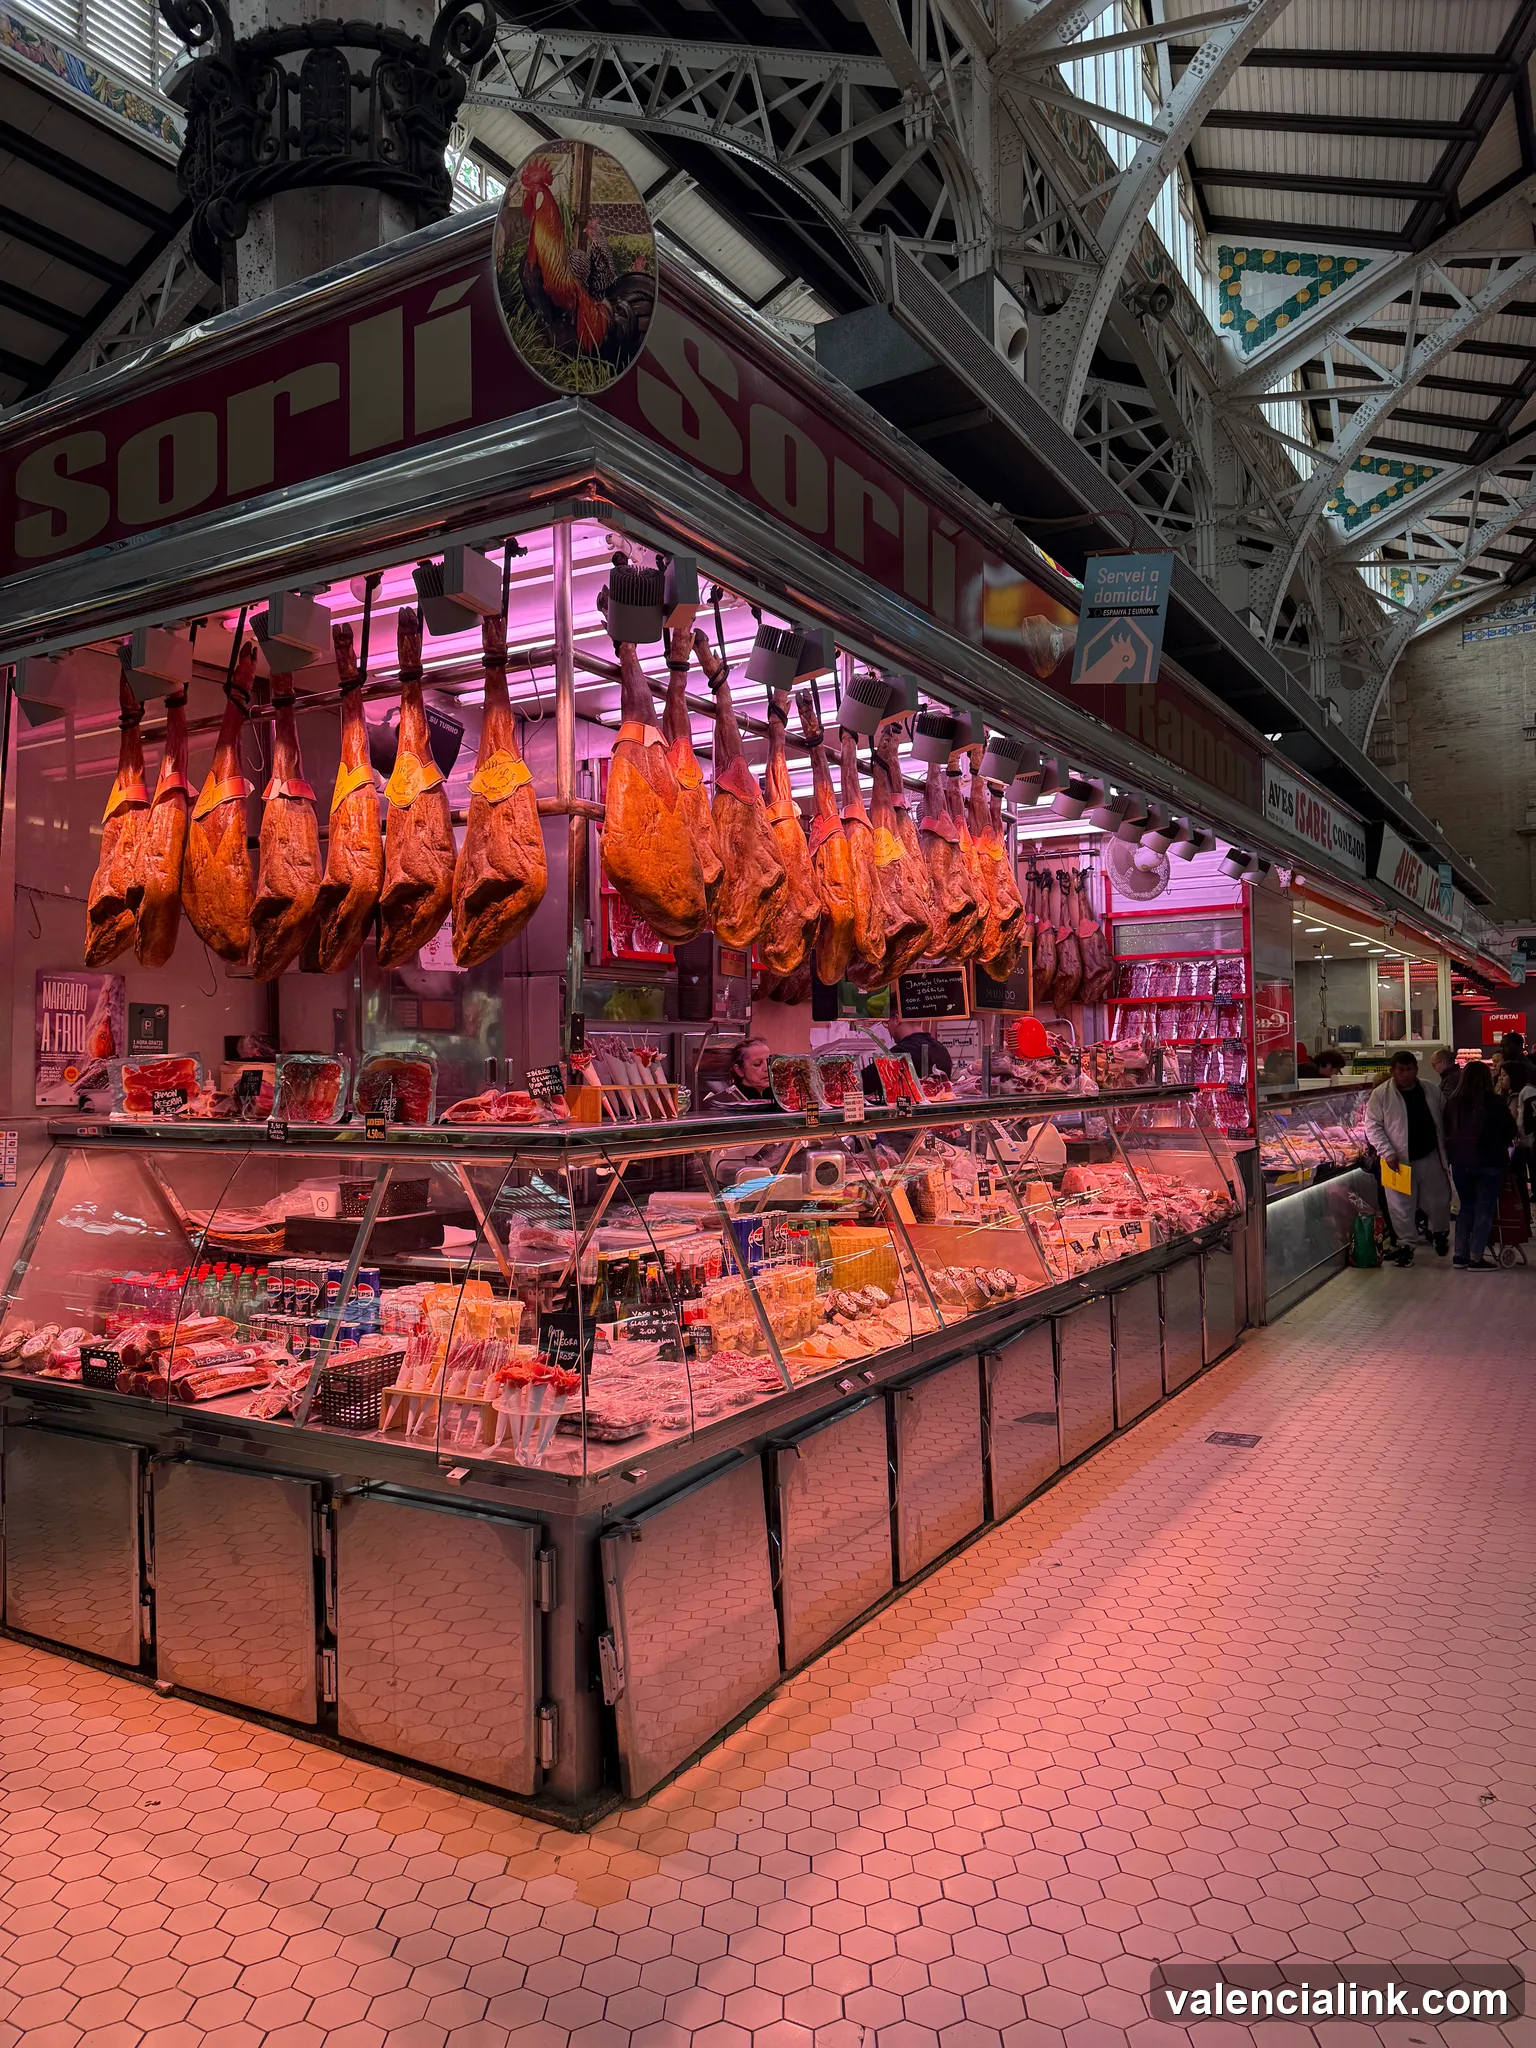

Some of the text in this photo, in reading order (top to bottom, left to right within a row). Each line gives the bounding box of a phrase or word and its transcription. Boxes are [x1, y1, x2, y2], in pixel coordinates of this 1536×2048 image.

[15, 274, 479, 559] Sorlí
[637, 299, 962, 631] Sorlí
[1097, 566, 1160, 585] Servei a
[1094, 585, 1158, 604] domicili
[1131, 607, 1154, 616] EUROPA
[428, 715, 459, 735] SU TURNO
[1125, 683, 1253, 808] Ramón
[1267, 780, 1365, 863] AVES ISABEL CONEJOS
[1393, 847, 1423, 899] AVES
[43, 980, 88, 1011] MARCADO
[986, 988, 1016, 1000] MUNDO
[41, 1010, 86, 1053] A FRÍO
[547, 1324, 565, 1338] PATA
[553, 1337, 578, 1347] NEGRA
